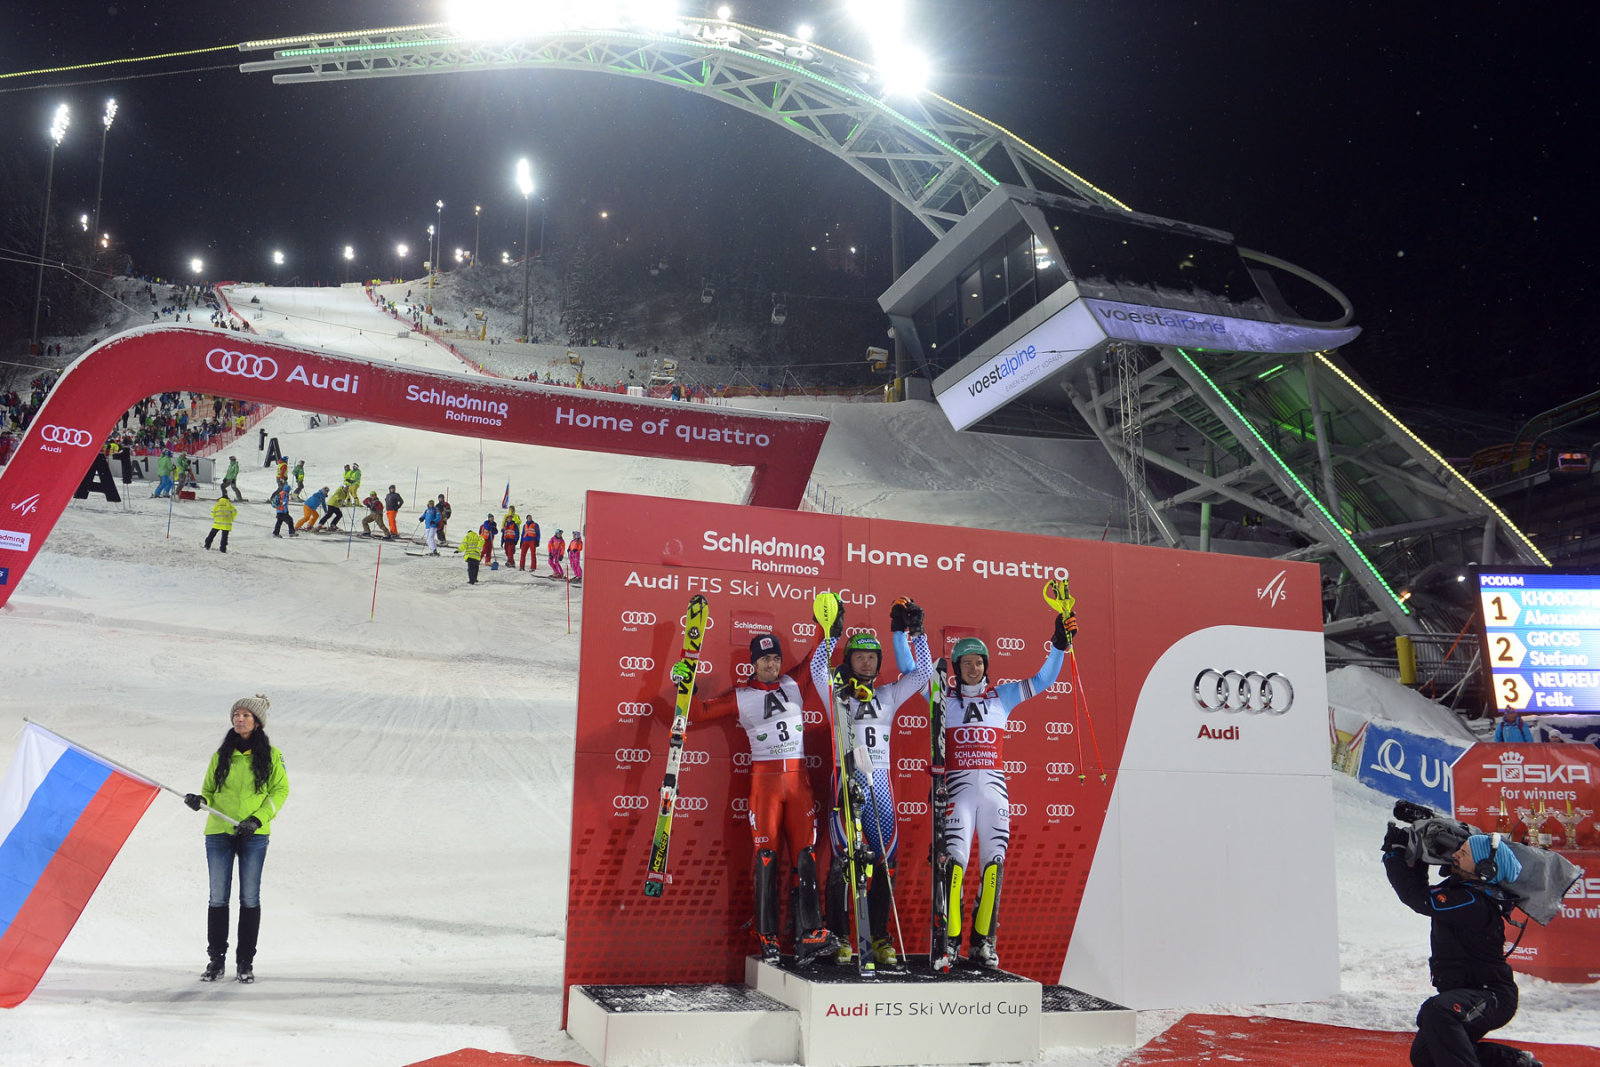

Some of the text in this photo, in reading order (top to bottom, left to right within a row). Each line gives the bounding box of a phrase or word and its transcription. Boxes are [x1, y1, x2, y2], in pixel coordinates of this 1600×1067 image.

[1098, 308, 1226, 334] voestalpine
[286, 365, 359, 394] Audi
[968, 345, 1036, 396] voestalpine
[406, 385, 508, 419] Schladming
[446, 410, 502, 427] Rohrmoos
[555, 407, 770, 447] Home of quattro
[40, 444, 62, 453] Audi
[73, 448, 132, 502] A1
[703, 531, 825, 565] Schladming
[752, 558, 819, 576] Rohrmoos
[848, 543, 1069, 581] Home of quattro
[624, 571, 679, 590] Audi
[688, 576, 722, 593] FIS
[730, 580, 759, 597] Ski
[838, 588, 876, 608] Cup
[1480, 576, 1524, 586] PODIUM
[1491, 596, 1507, 620] 1
[734, 621, 772, 632] Schladming
[1496, 637, 1514, 662] 2
[1527, 632, 1581, 646] GROSS
[1530, 651, 1588, 666] Stefano
[1502, 678, 1519, 702] 3
[1536, 692, 1574, 707] Felix
[764, 686, 790, 720] A1
[962, 700, 988, 724] A1
[776, 721, 790, 742] 3
[865, 726, 876, 748] 6
[1198, 724, 1240, 740] Audi
[954, 750, 998, 758] SCHLADMING
[958, 758, 994, 768] DACHSTEIN
[1482, 764, 1590, 784] JOSKA
[1501, 787, 1576, 800] for winners
[1562, 904, 1582, 918] for
[826, 1001, 1028, 1017] Audi FIS Ski World Cup
